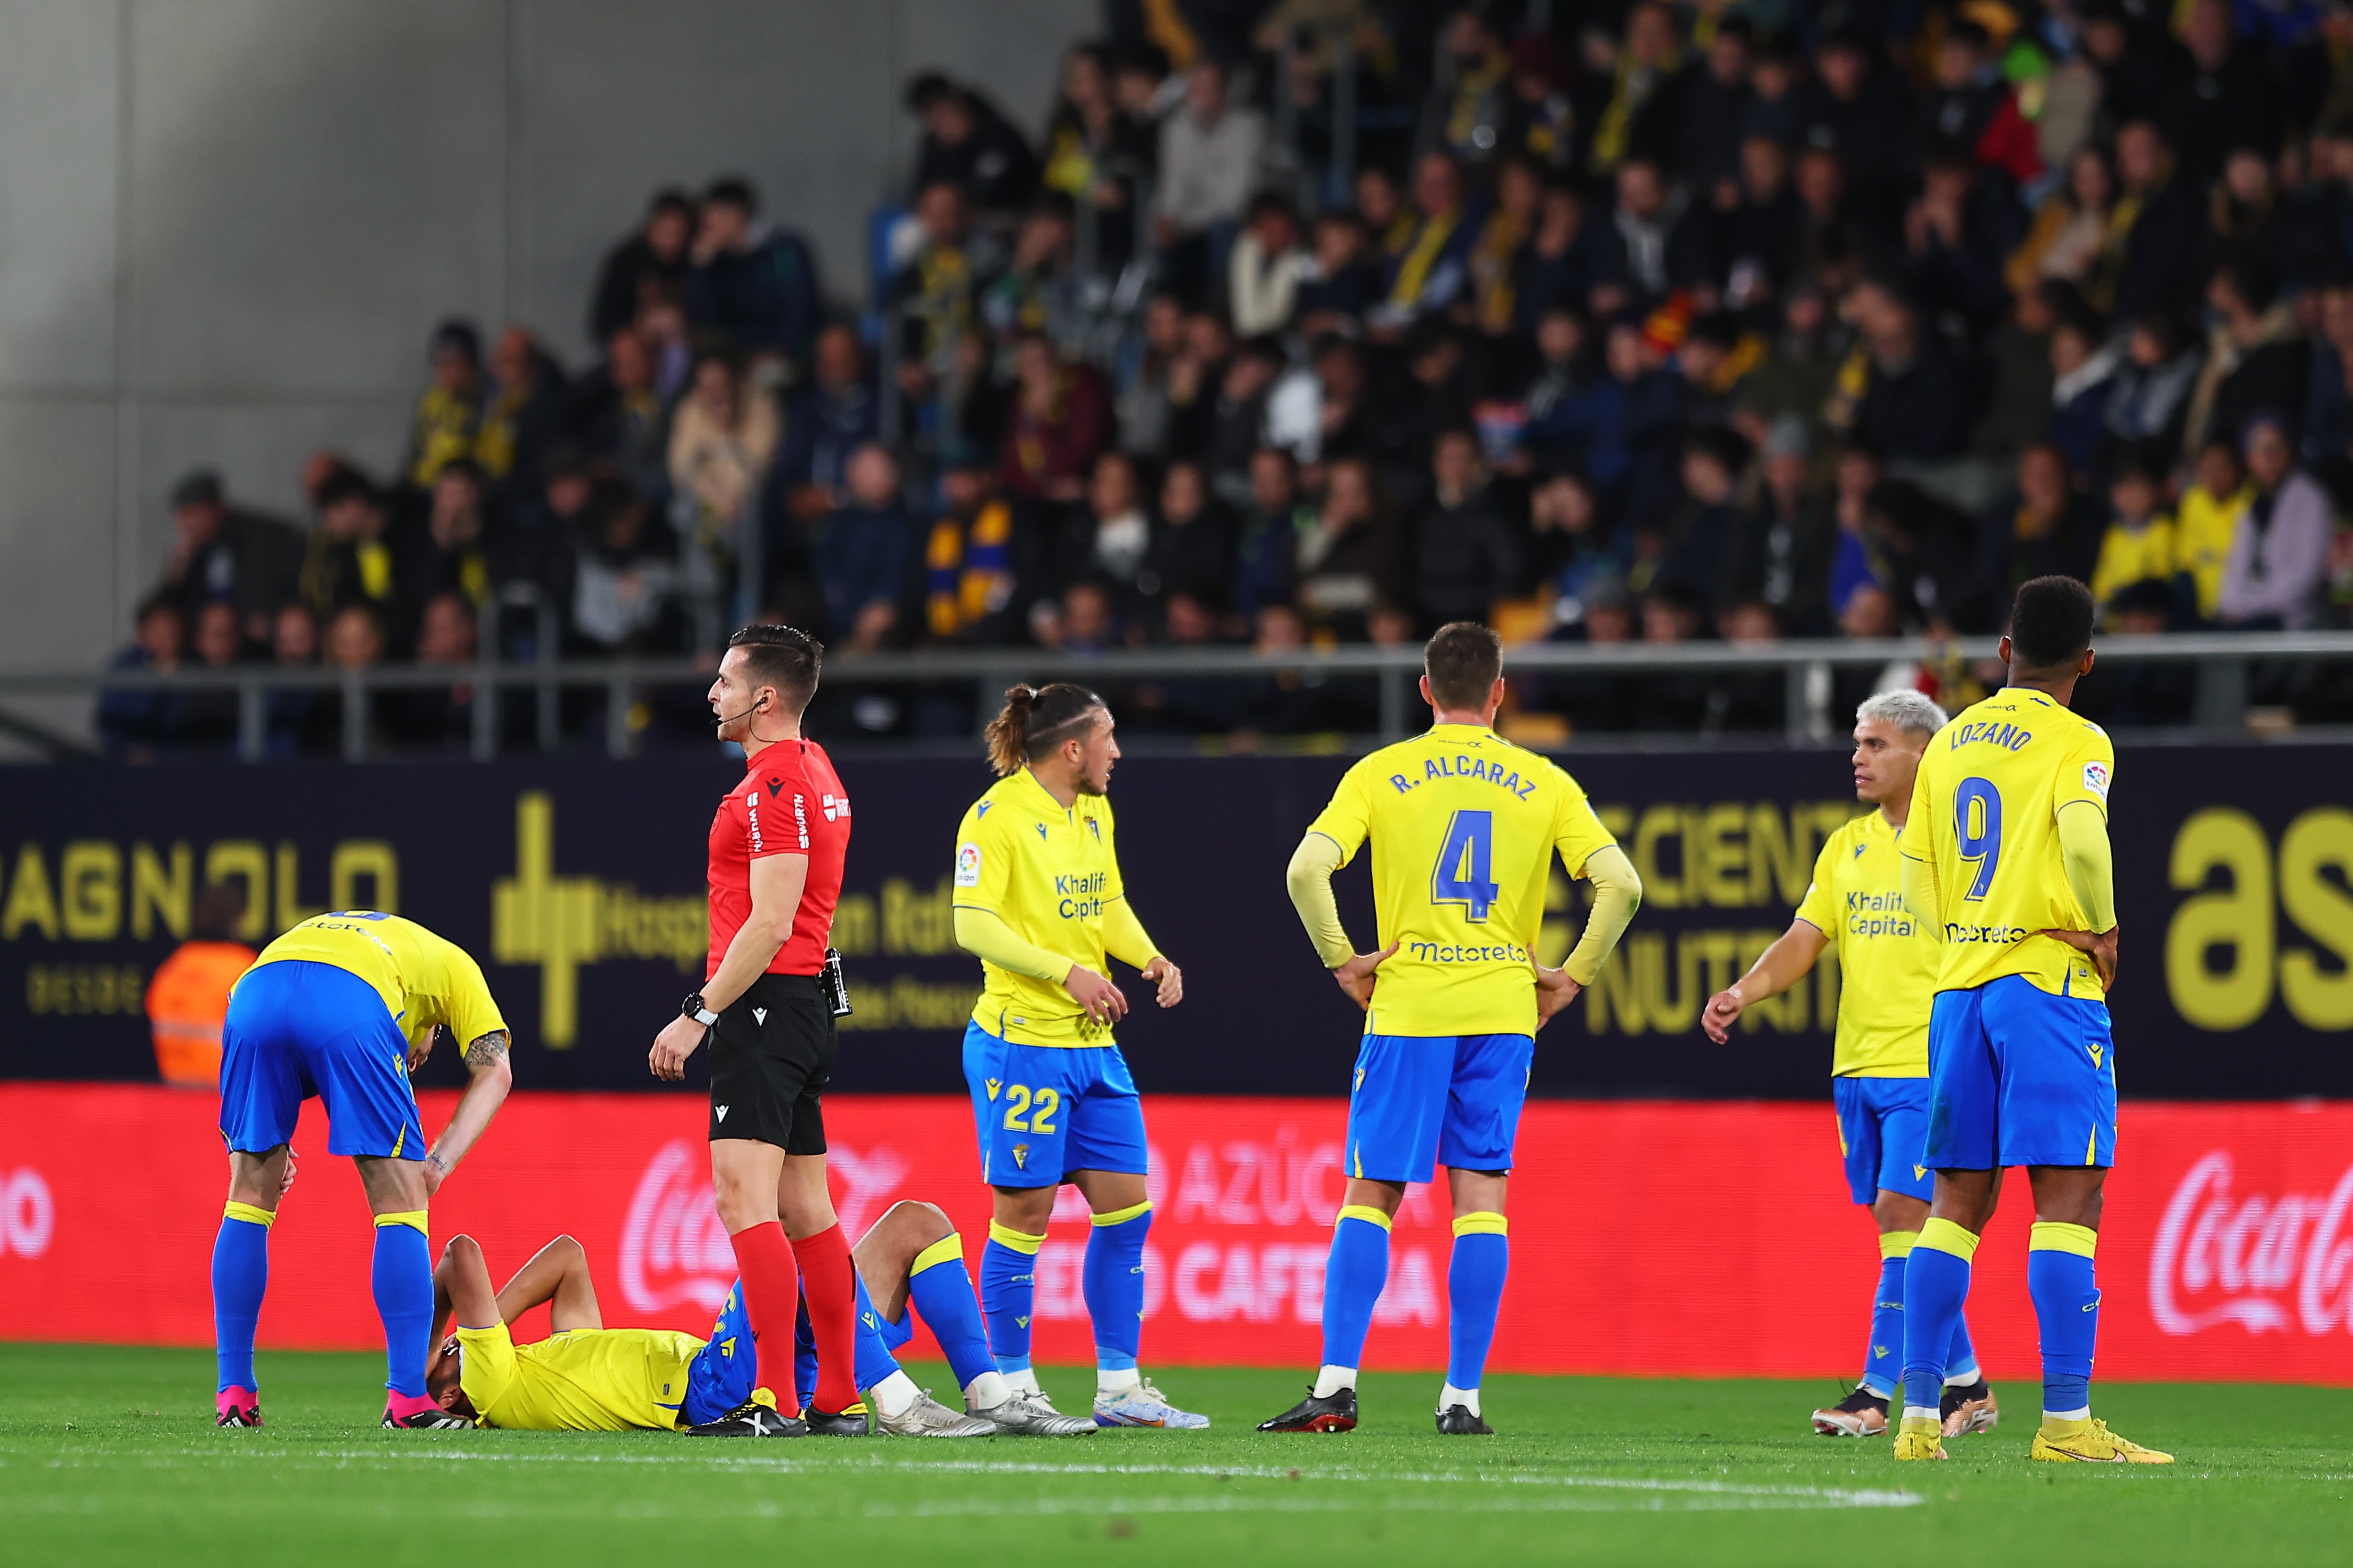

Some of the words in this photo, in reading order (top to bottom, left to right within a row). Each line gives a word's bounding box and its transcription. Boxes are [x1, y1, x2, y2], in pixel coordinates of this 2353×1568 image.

[1951, 722, 2032, 752] LOZANO
[1390, 774, 1420, 795] R.
[1424, 755, 1536, 802] ALCARAZ
[793, 793, 808, 835] WÜRTH
[835, 798, 852, 818] WÜRT
[1953, 776, 2002, 902] 9
[1431, 810, 1498, 924] 4
[0, 841, 399, 939] AGNOLO
[1847, 892, 1911, 913] Khalif
[1849, 915, 1917, 940] Capital
[1003, 1084, 1059, 1135] 22
